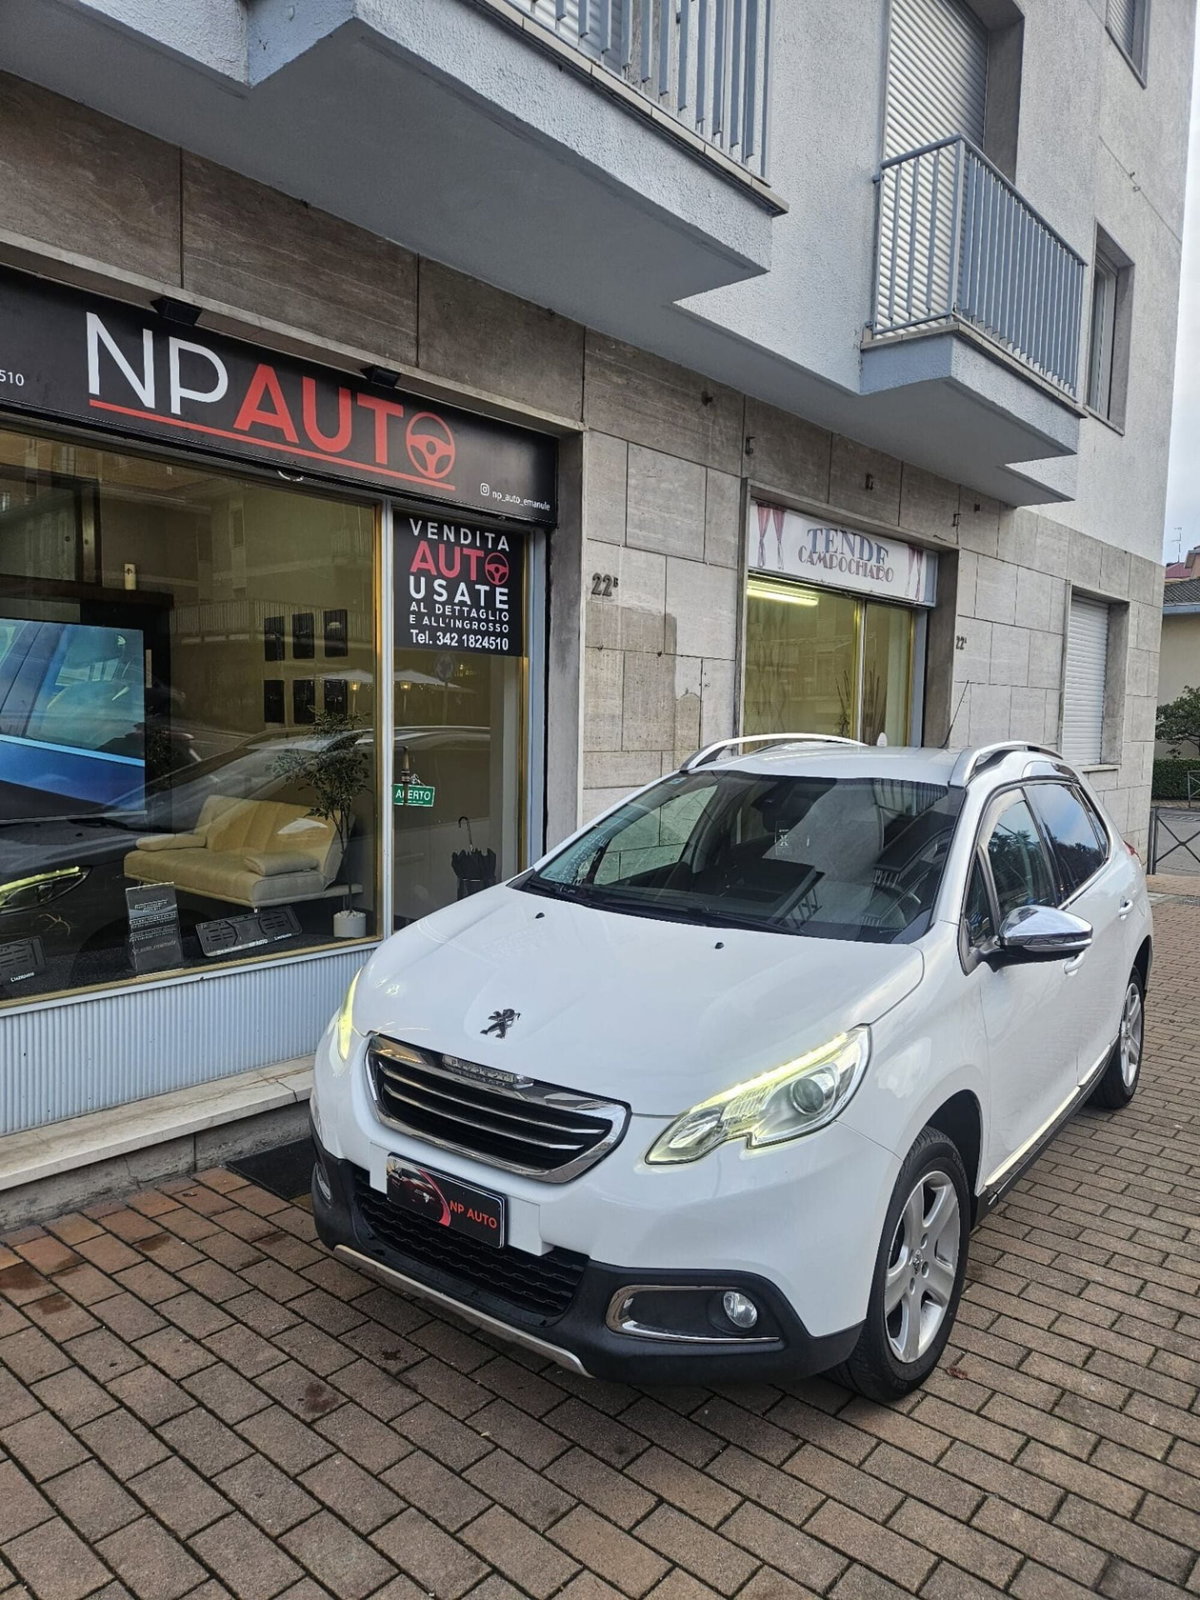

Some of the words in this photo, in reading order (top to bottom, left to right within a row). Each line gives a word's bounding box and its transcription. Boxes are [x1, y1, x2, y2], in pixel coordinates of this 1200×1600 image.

[409, 518, 510, 552] VENDITA
[806, 528, 889, 565] TENDE
[409, 575, 509, 610] USATE
[409, 614, 416, 624] E
[422, 615, 509, 633] ALL'INGROSSO
[410, 601, 428, 613] AL
[435, 603, 509, 621] DETTAGLIO
[410, 629, 433, 644] Tel.
[436, 632, 459, 647] 342
[462, 634, 509, 651] 1824510
[396, 789, 431, 801] AERTO
[449, 1200, 465, 1214] NP
[466, 1209, 498, 1229] AUTO
